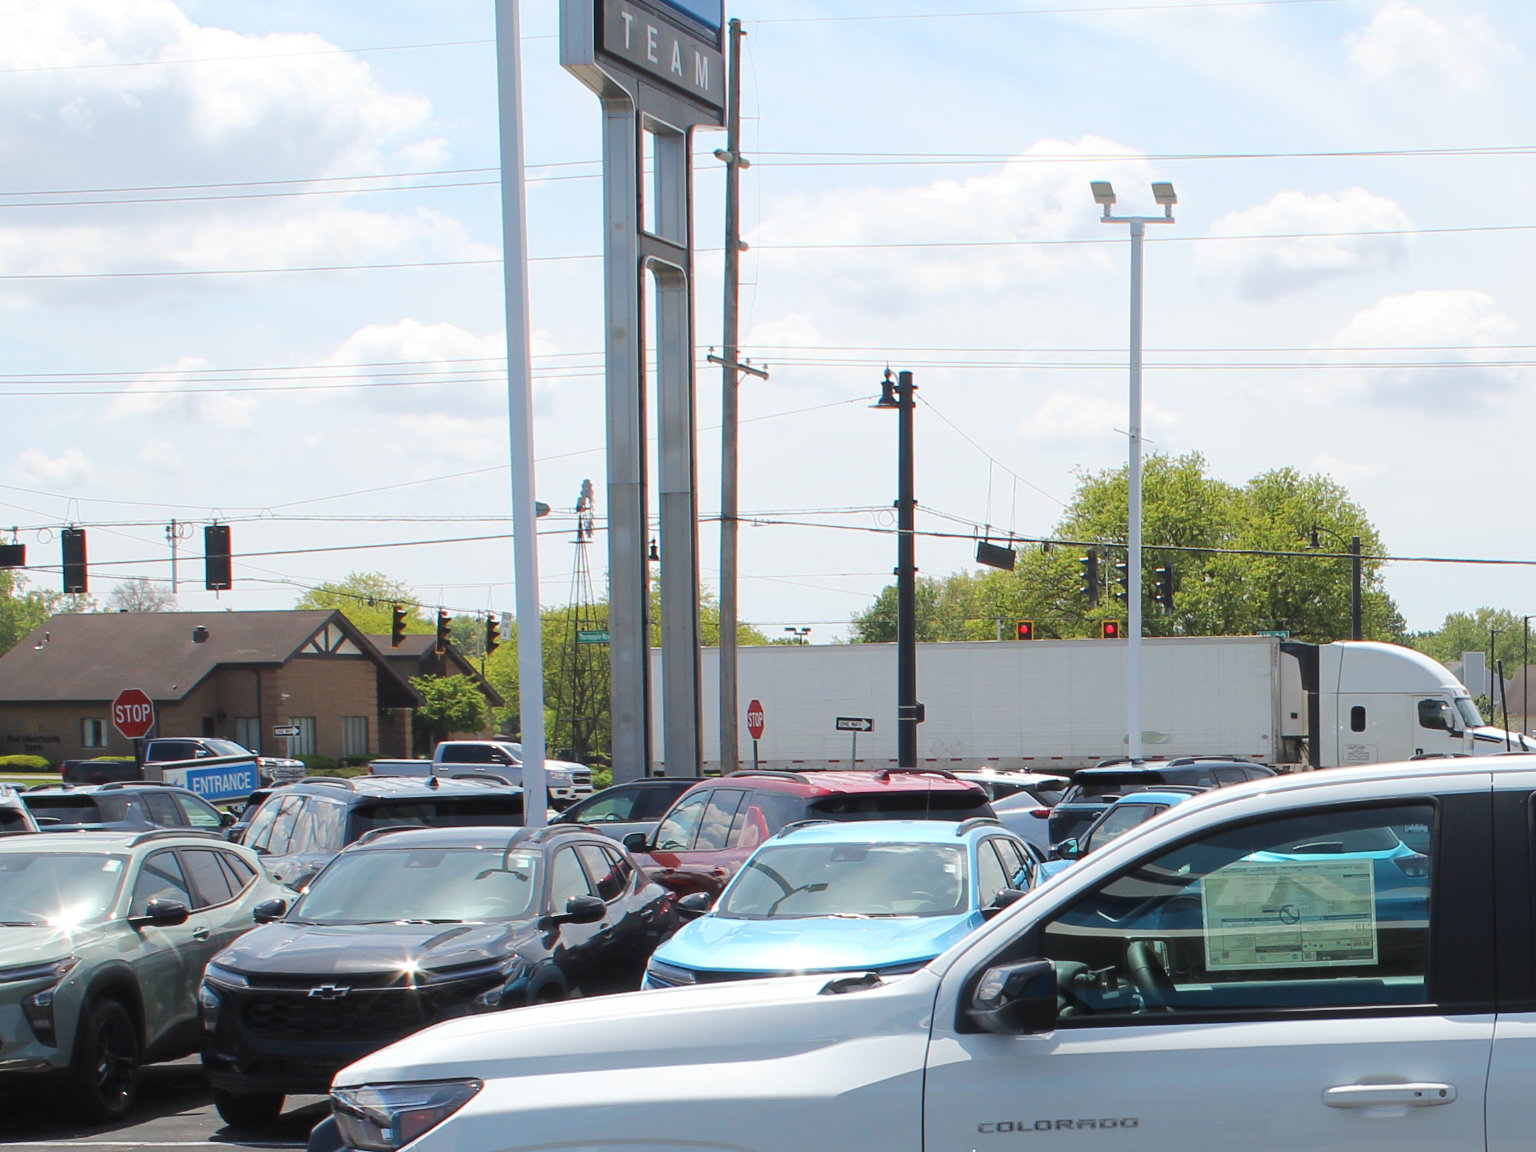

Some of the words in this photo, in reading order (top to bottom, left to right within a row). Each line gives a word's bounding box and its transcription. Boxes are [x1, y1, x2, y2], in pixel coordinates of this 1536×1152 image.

[621, 11, 709, 91] TEAM
[115, 704, 151, 724] STOP
[747, 712, 765, 728] STOP
[839, 720, 850, 728] ONE
[193, 772, 252, 795] ENTRANCE
[977, 1117, 1139, 1134] COLORADO
